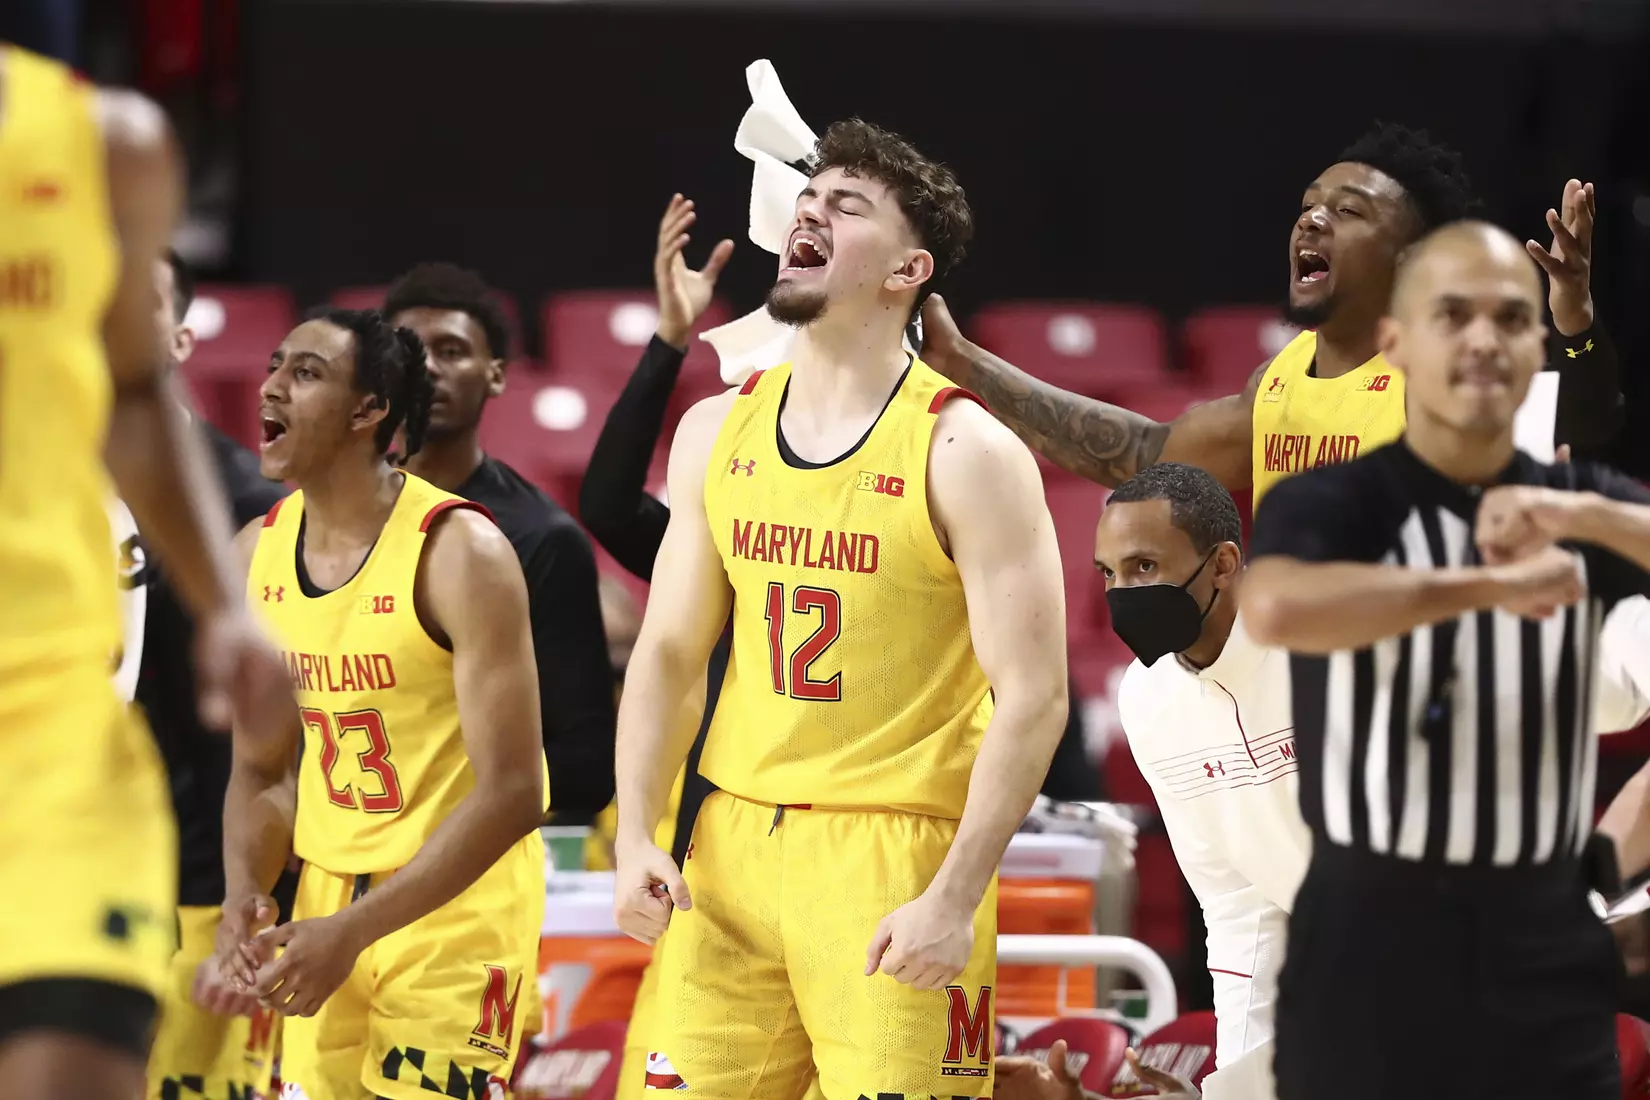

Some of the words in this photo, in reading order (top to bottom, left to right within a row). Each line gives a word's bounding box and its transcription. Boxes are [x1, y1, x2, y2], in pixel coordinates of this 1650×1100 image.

[1264, 433, 1360, 473] MARYLAND
[732, 519, 880, 574] MARYLAND
[764, 581, 842, 702] 12
[300, 706, 404, 813] 23
[942, 985, 992, 1065] M
